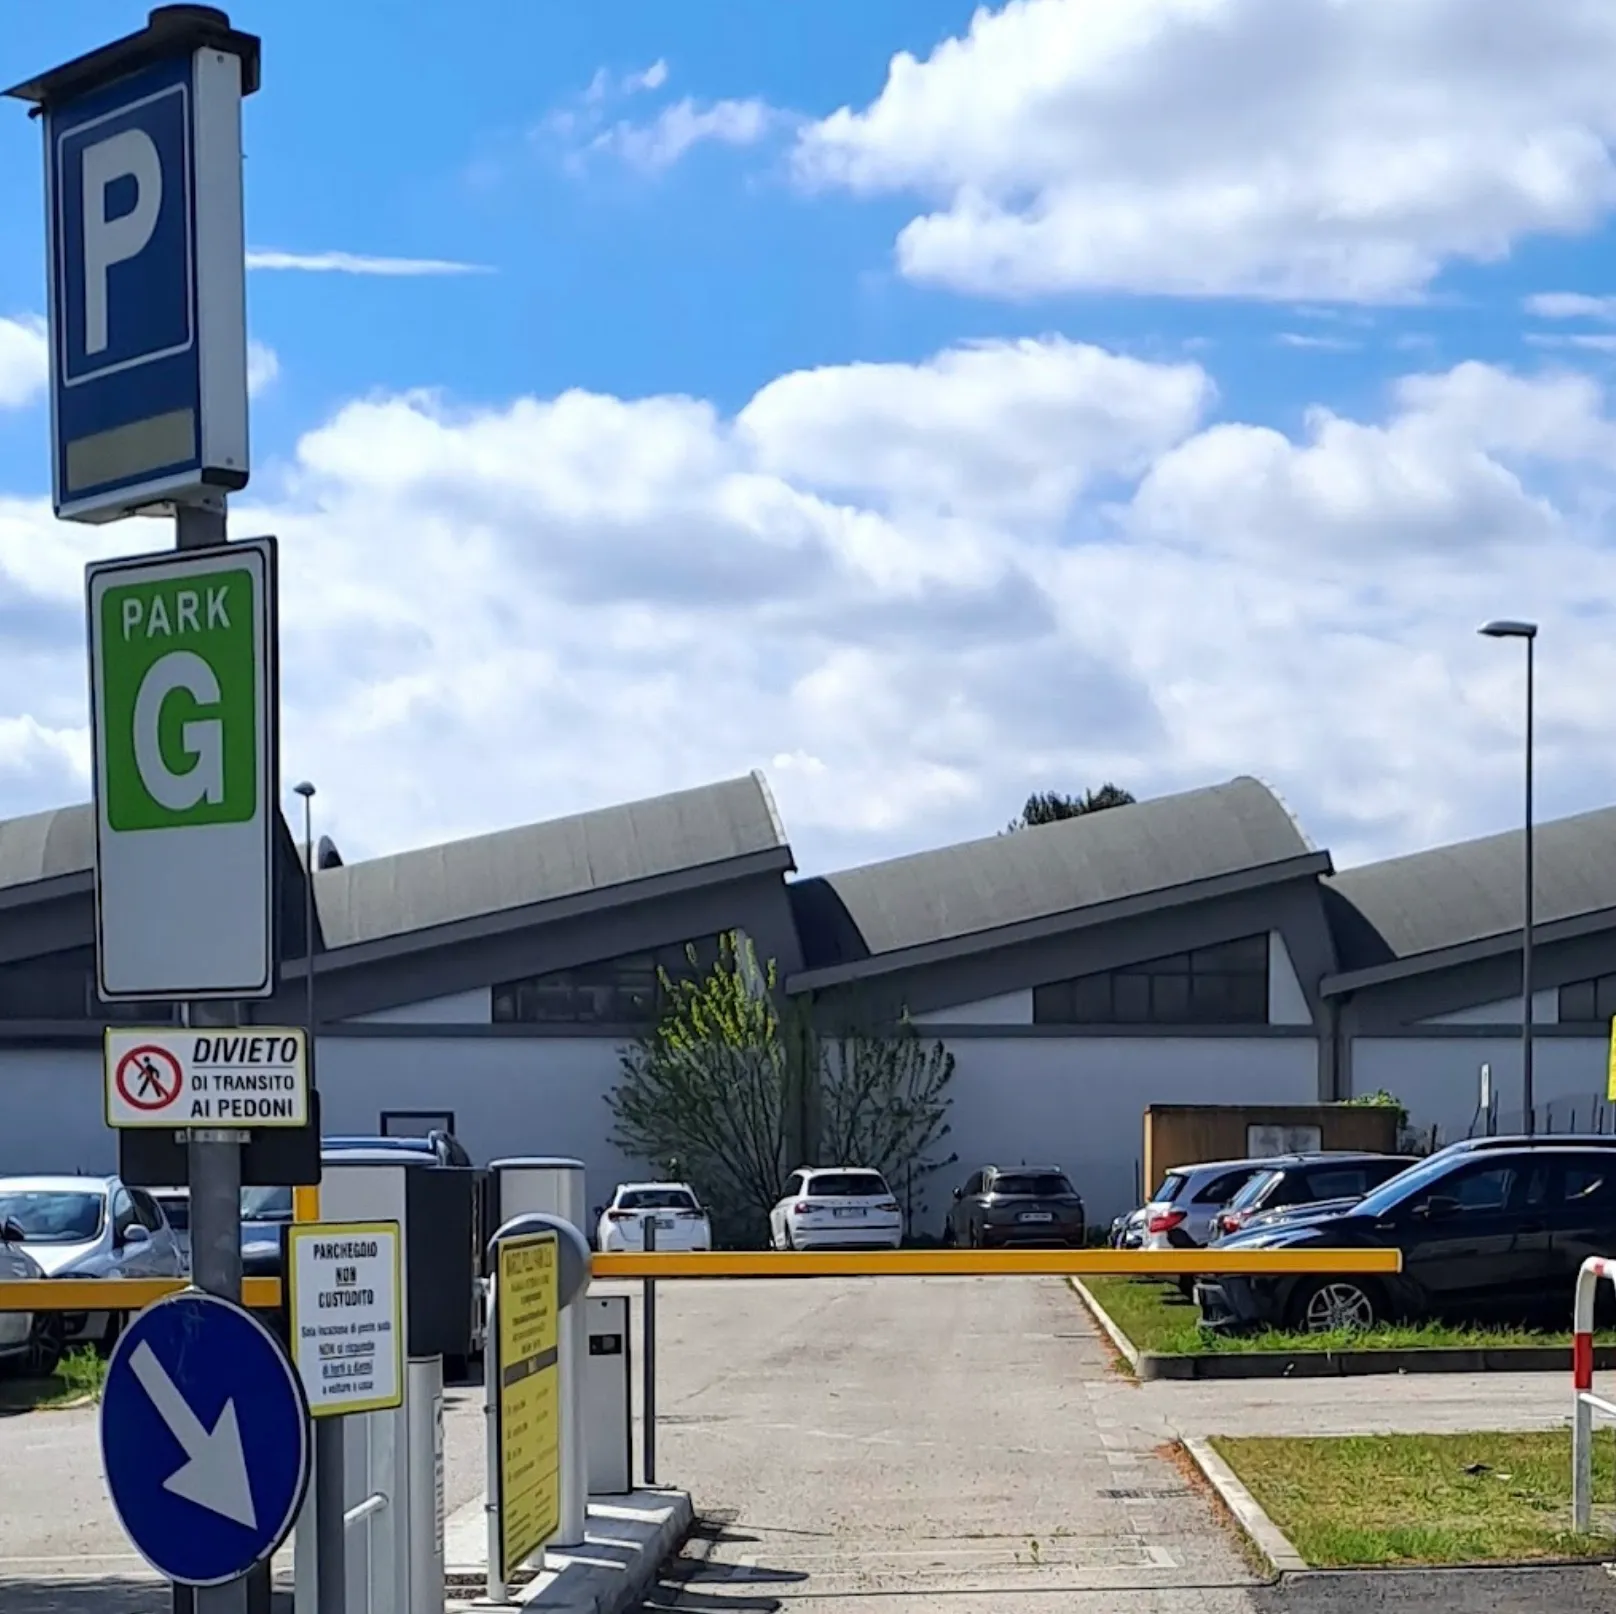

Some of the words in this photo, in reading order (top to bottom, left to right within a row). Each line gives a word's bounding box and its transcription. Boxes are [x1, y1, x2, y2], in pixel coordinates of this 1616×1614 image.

[82, 128, 162, 356] P
[122, 586, 231, 641] PARK
[132, 650, 225, 811] G
[192, 1037, 298, 1063] DIVIETO
[191, 1075, 208, 1091] DI
[214, 1075, 295, 1091] TRANSITO
[190, 1099, 209, 1118] AI
[218, 1098, 293, 1118] PEDONI
[313, 1241, 378, 1260] PARCHEGGIO
[336, 1266, 357, 1283] NON
[318, 1289, 374, 1309] CUSTODITO
